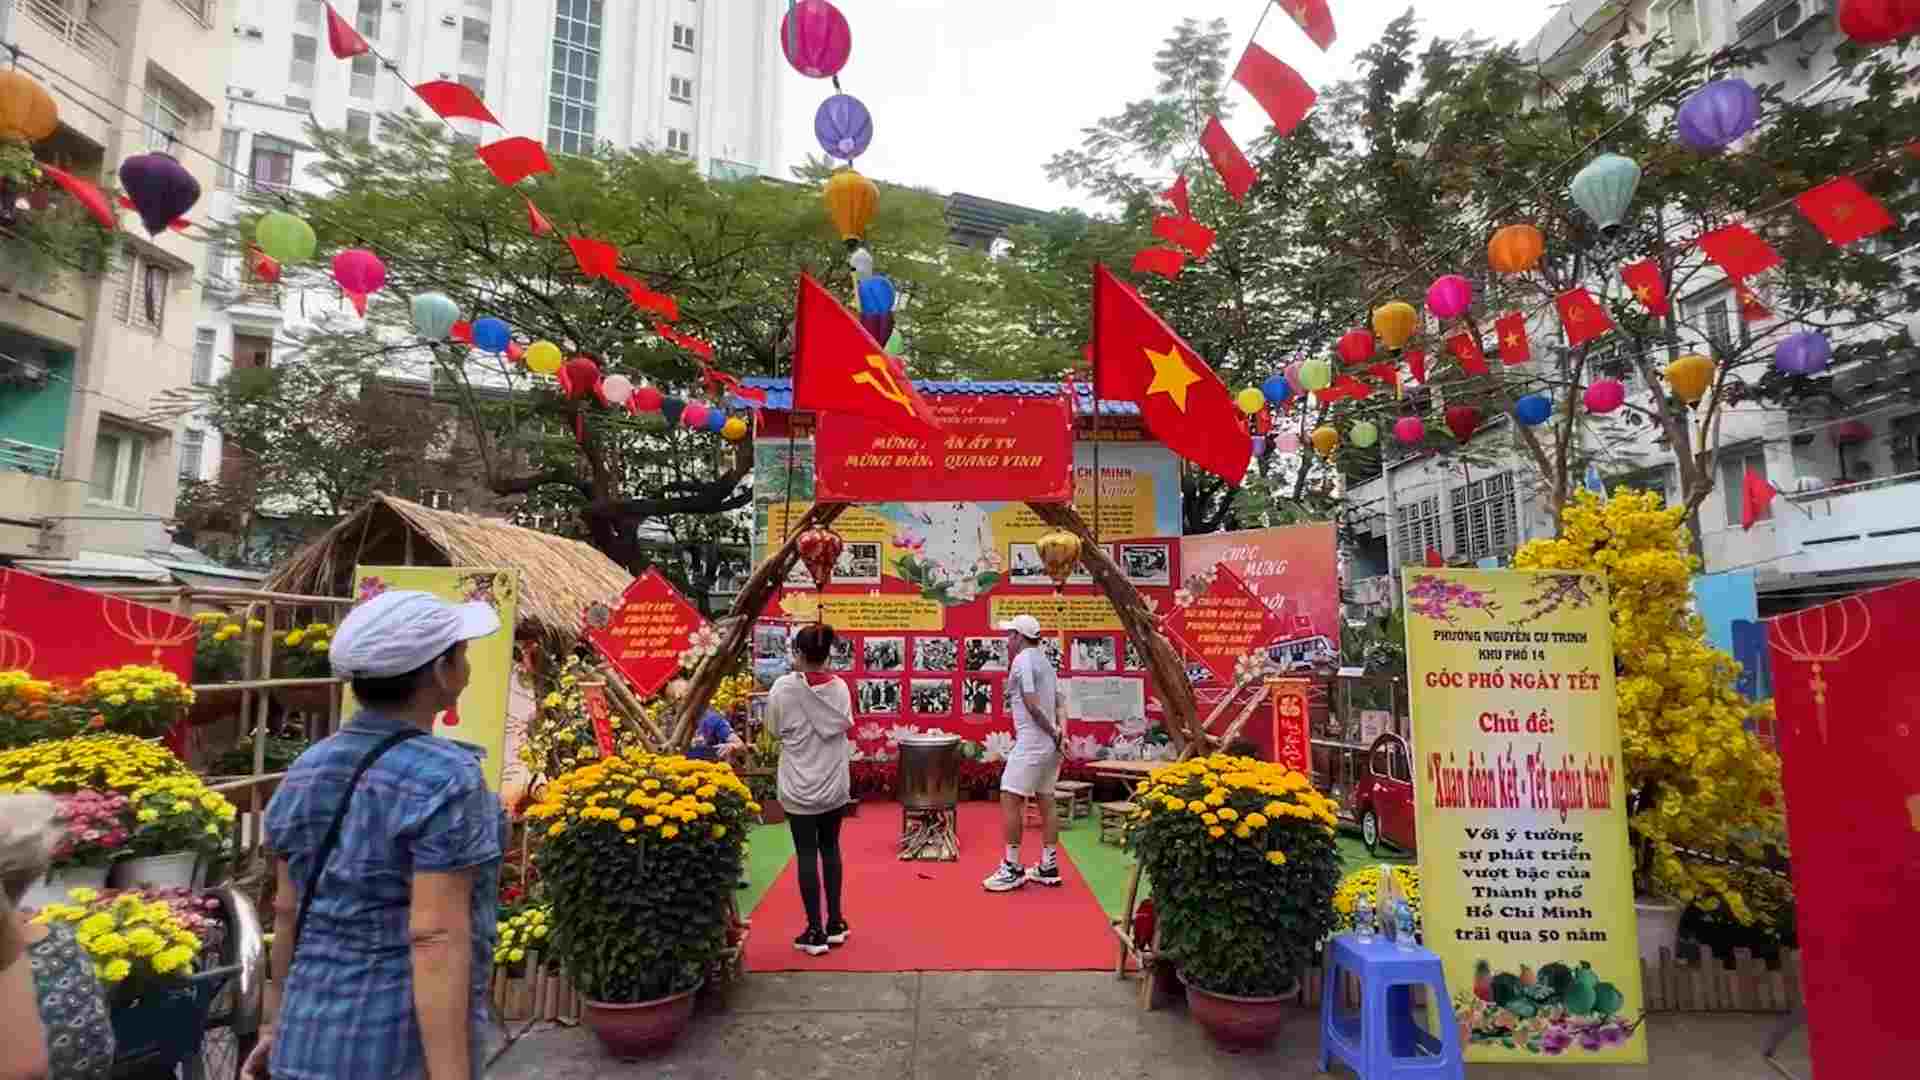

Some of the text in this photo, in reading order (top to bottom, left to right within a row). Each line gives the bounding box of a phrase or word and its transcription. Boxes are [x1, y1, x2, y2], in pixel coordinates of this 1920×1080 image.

[944, 455, 999, 469] QUANG
[1002, 456, 1043, 467] VINH
[1552, 632, 1588, 643] TRINH
[1479, 646, 1545, 660] KHU PHỐ 14
[1425, 666, 1601, 690] GÓC PHỐ NGÀY TẾT
[1479, 708, 1554, 733] Chủ đề:
[1498, 742, 1520, 808] kết
[1526, 742, 1549, 809] Tết
[1465, 828, 1499, 840] Với
[1505, 828, 1518, 842] ý
[1458, 845, 1592, 863] sự phát triển
[1462, 866, 1591, 882] vượt bậc của
[1472, 884, 1583, 901] Thành phố
[1466, 904, 1592, 919] Hồ Chí Minh
[1496, 929, 1532, 943] qua
[1538, 930, 1560, 942] 50
[1566, 928, 1607, 941] năm
